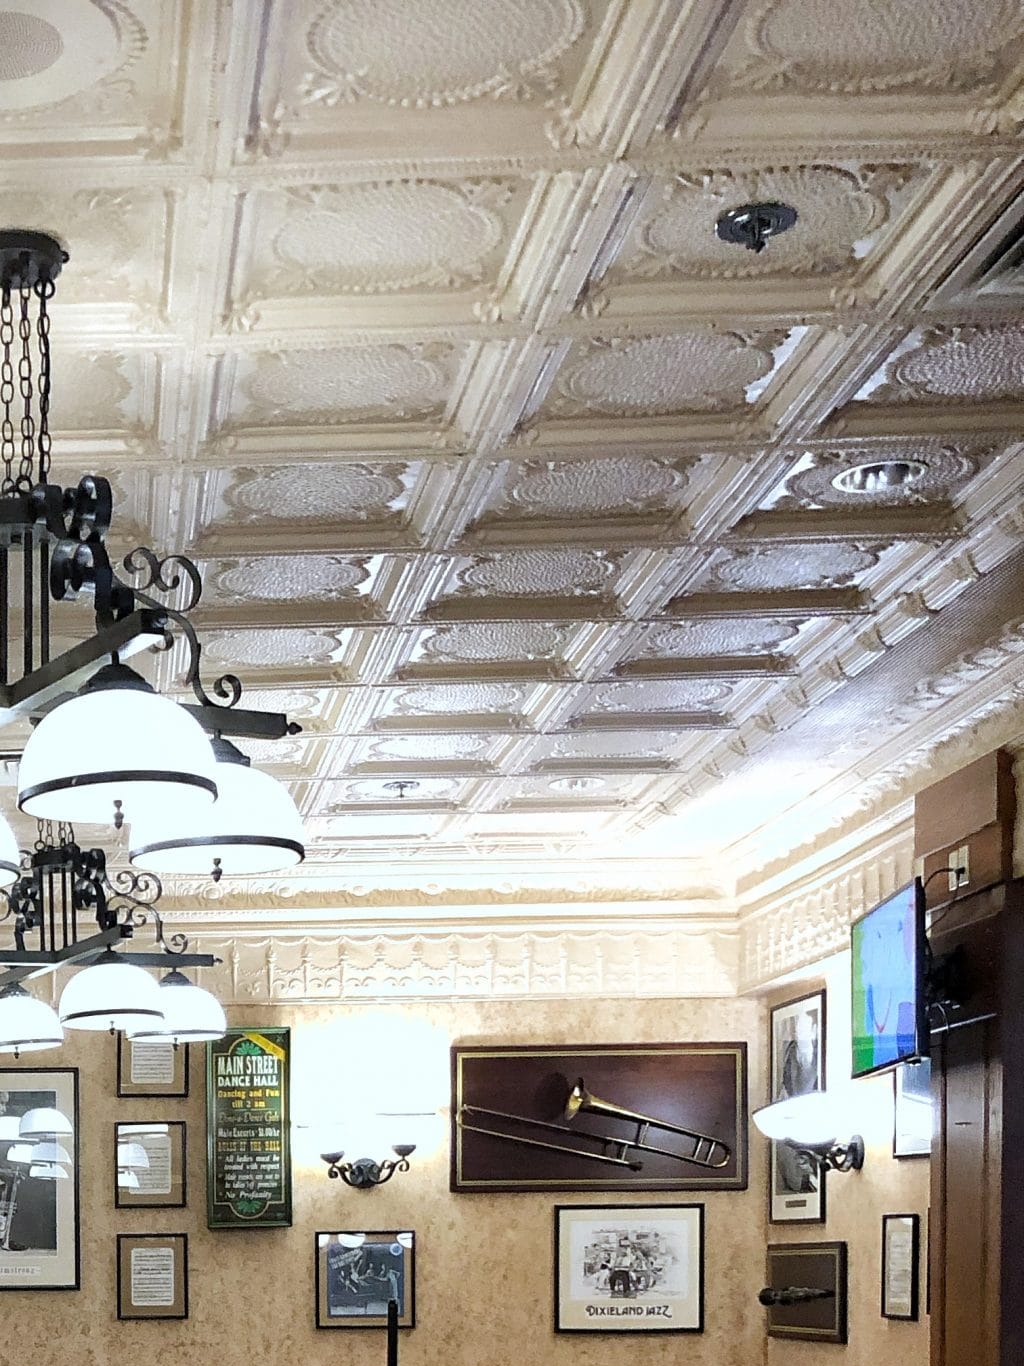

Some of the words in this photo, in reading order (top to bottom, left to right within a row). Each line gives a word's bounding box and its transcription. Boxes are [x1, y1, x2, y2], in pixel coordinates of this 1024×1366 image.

[217, 1055, 244, 1075] MAIN
[246, 1055, 278, 1075] STREET
[217, 1076, 250, 1087] DANCE
[253, 1075, 279, 1086] HALL
[217, 1089, 246, 1099] Dancing
[249, 1088, 262, 1097] and
[246, 1100, 252, 1108] 2
[585, 1305, 644, 1317] DIXIELAND
[646, 1305, 673, 1318] JAZZ
